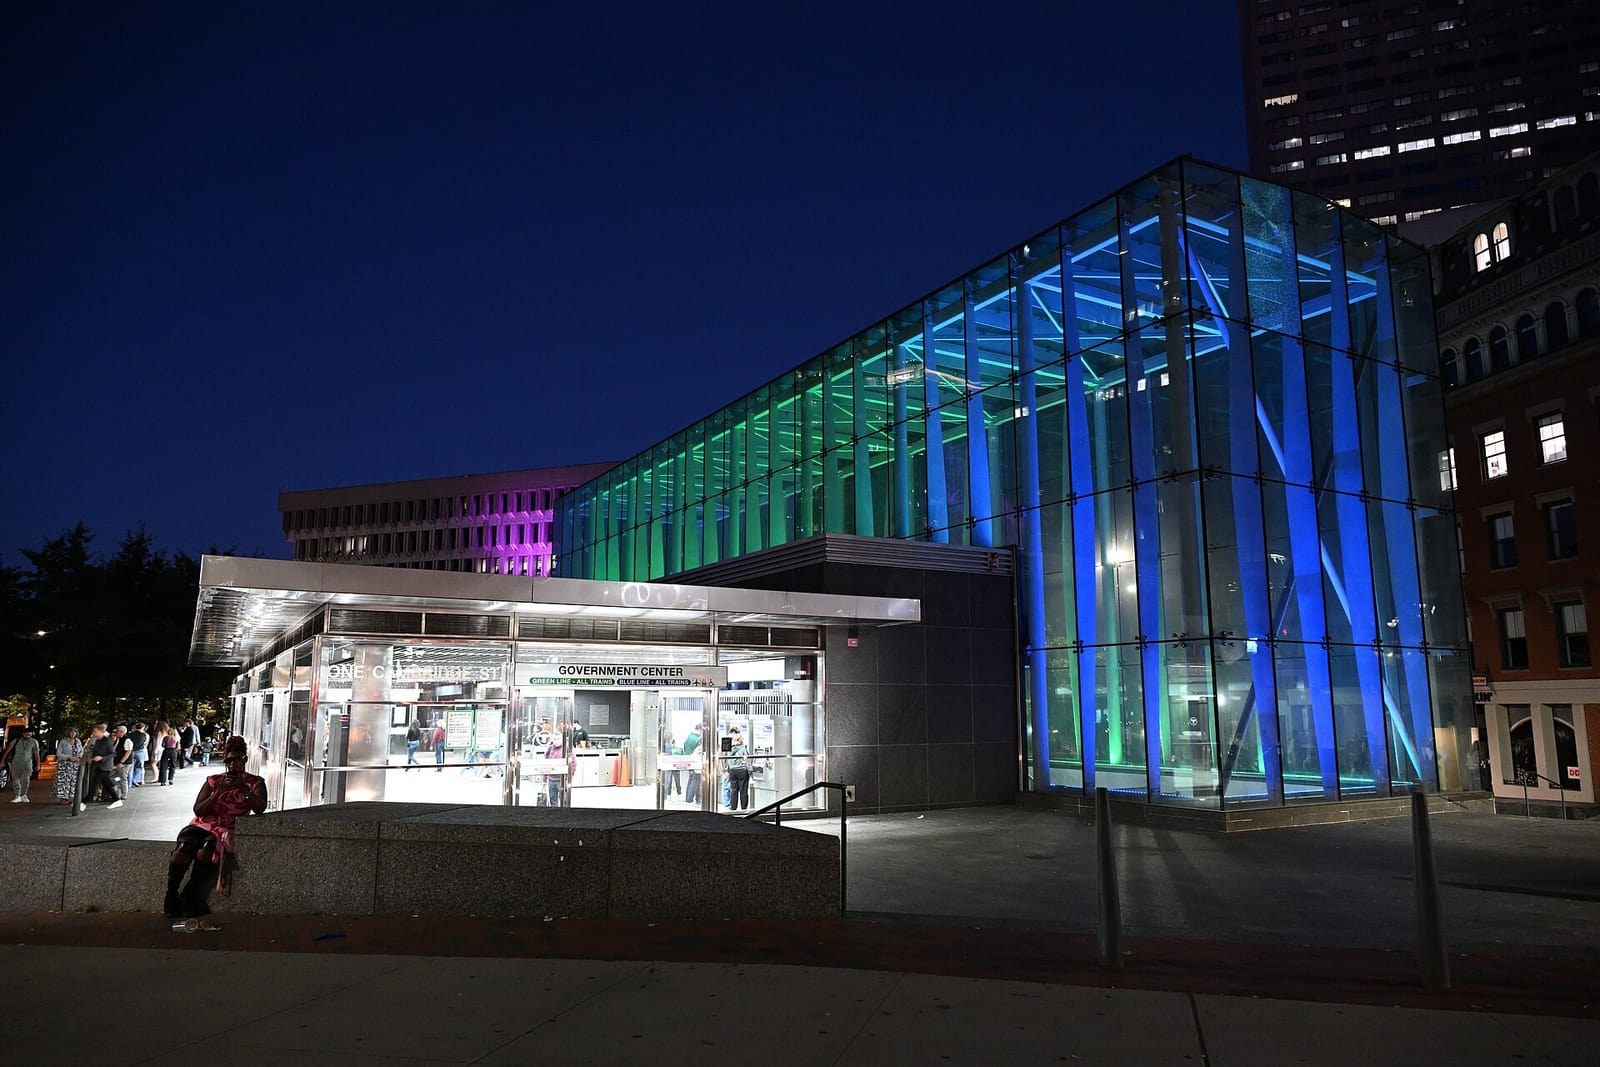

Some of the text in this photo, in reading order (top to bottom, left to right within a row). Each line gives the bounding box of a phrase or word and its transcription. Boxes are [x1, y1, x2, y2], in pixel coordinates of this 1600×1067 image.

[328, 664, 365, 679] ONE
[372, 665, 470, 680] CRIDGE
[558, 665, 683, 677] GOVERNMENT CENTER
